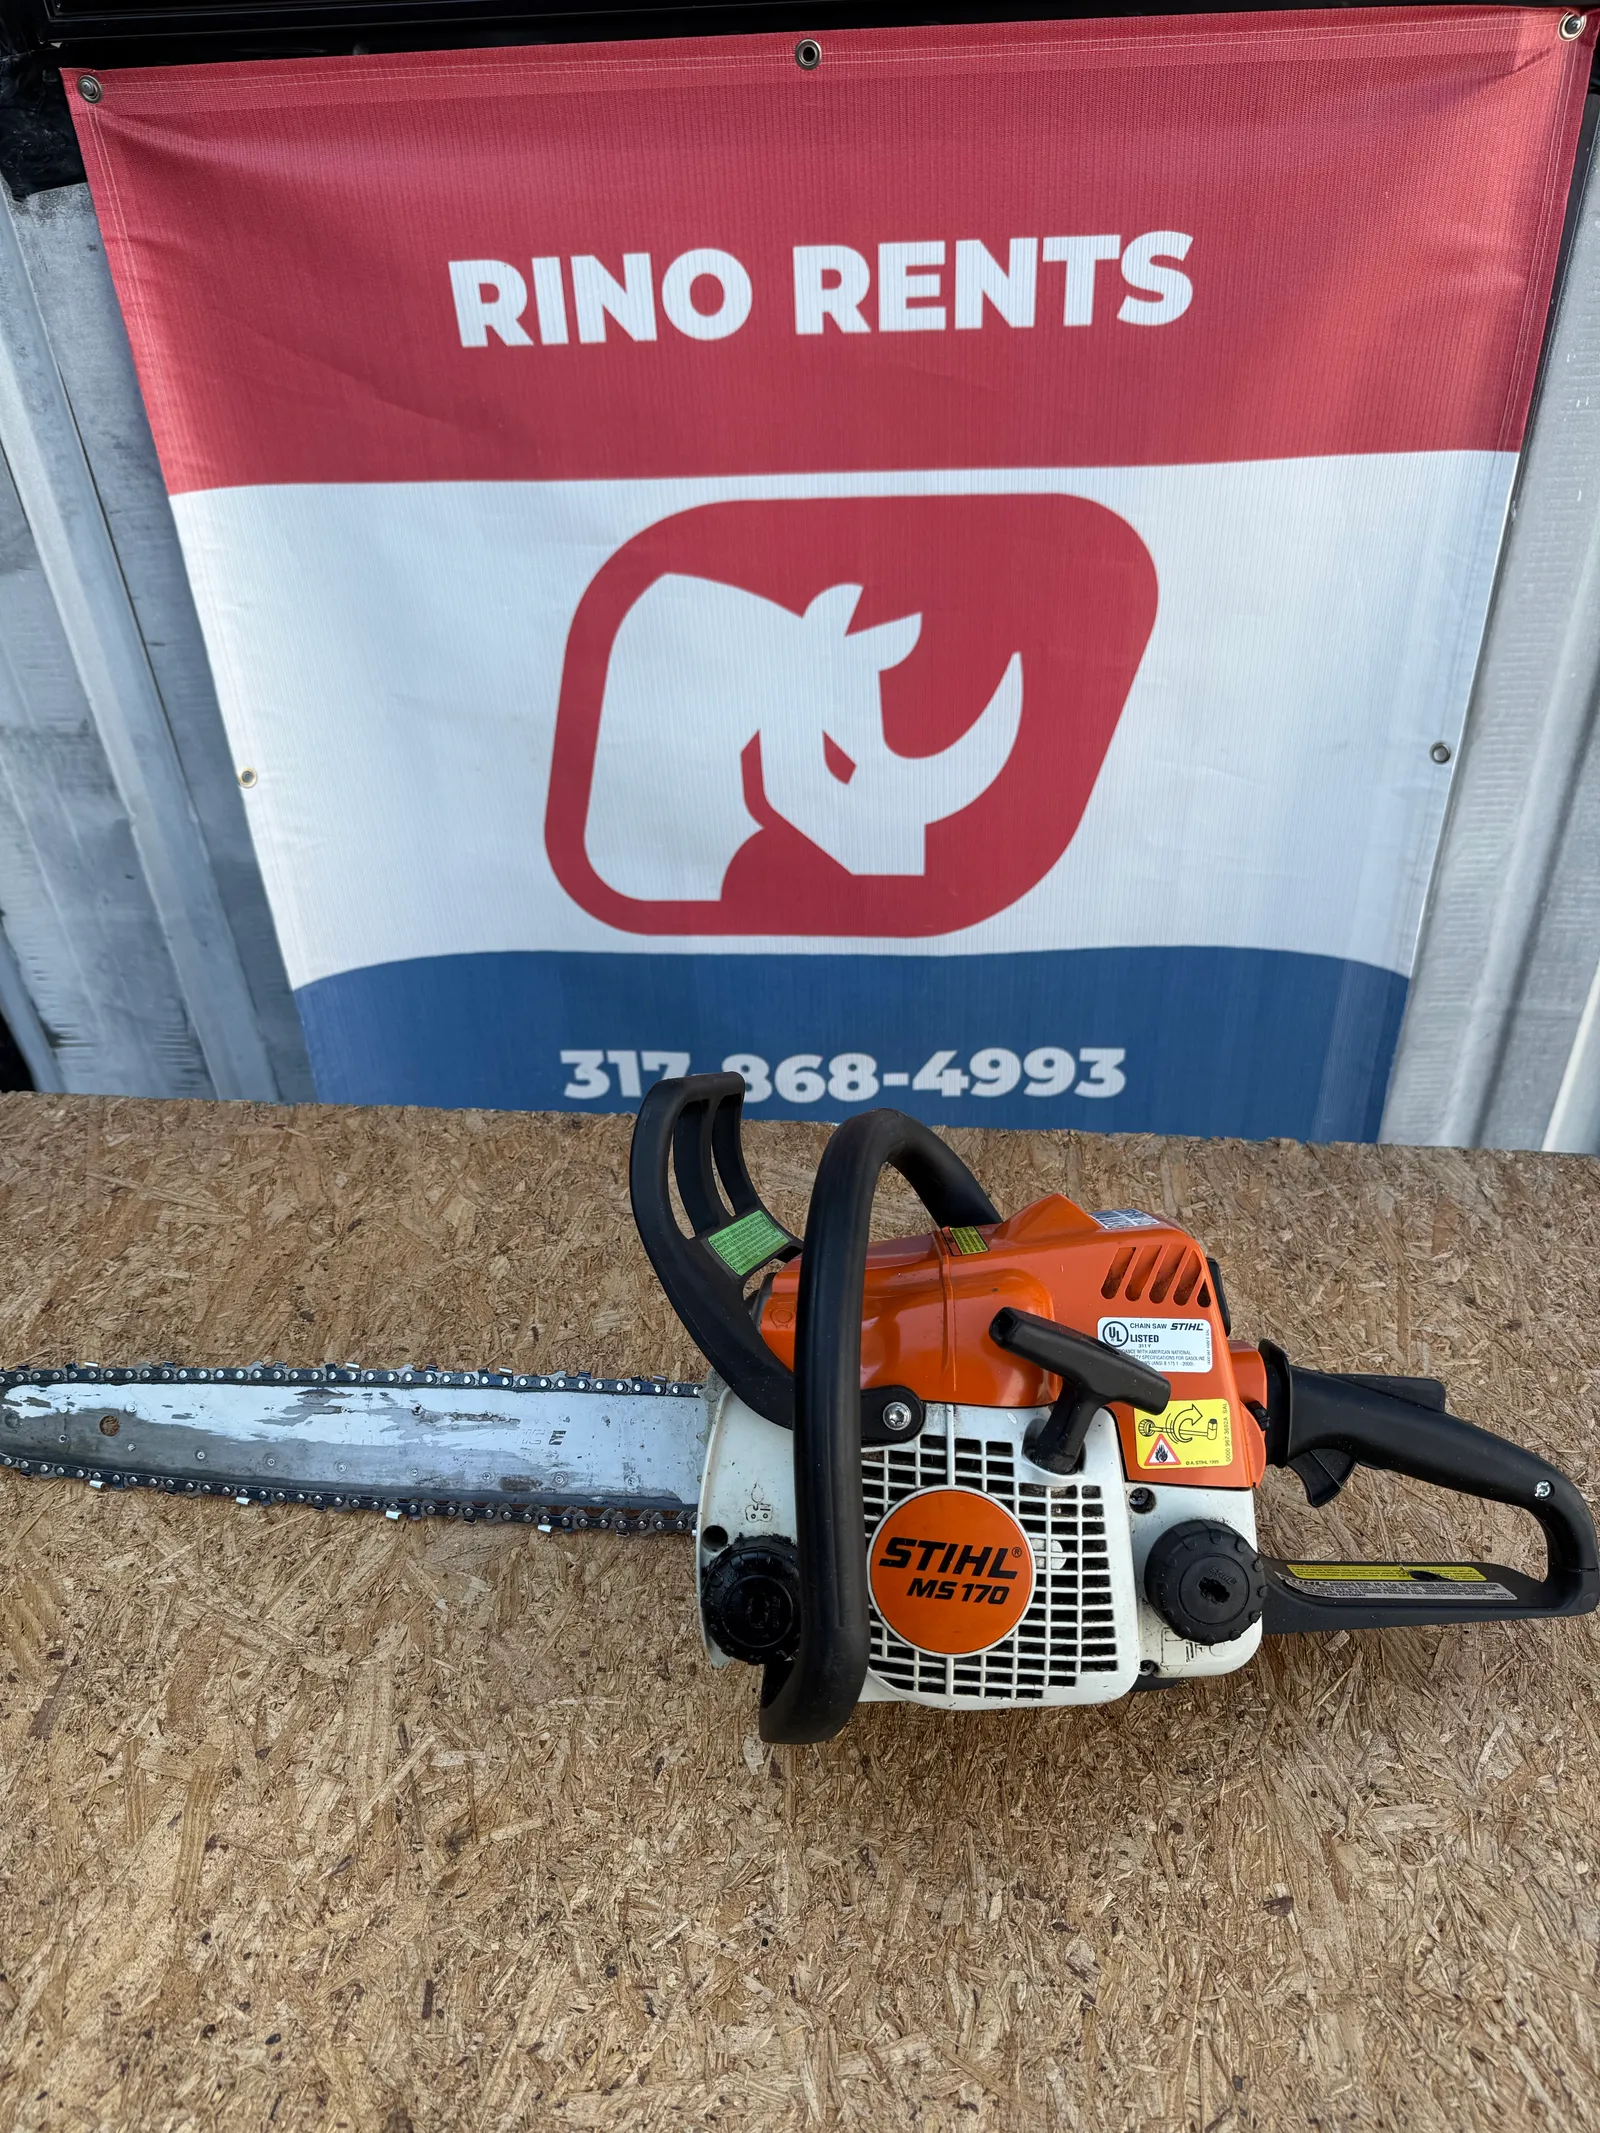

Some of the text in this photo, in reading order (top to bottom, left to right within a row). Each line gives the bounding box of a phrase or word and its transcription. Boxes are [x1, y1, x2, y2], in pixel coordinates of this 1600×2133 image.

[448, 231, 1194, 348] RINO RENTS
[1130, 1334, 1160, 1343] LISTED
[906, 1577, 1010, 1605] MS 170
